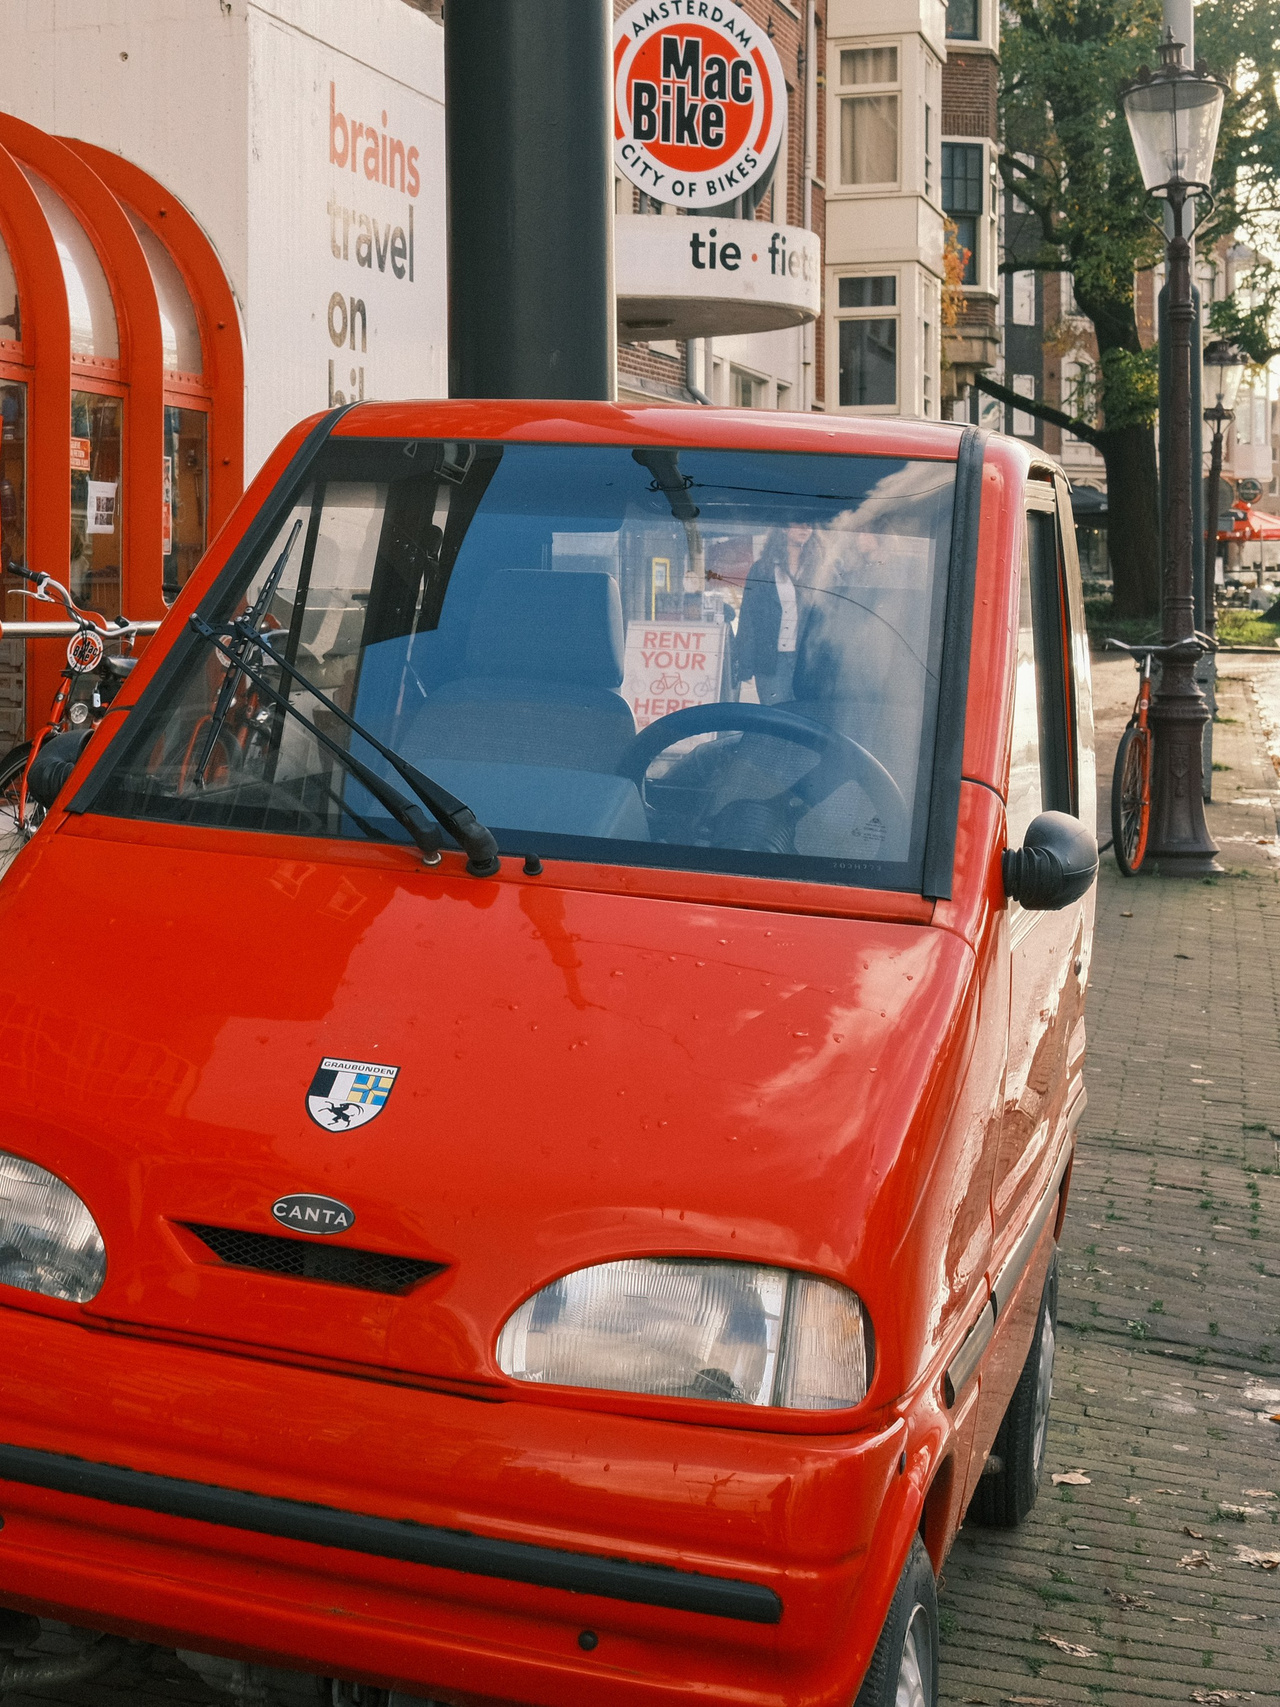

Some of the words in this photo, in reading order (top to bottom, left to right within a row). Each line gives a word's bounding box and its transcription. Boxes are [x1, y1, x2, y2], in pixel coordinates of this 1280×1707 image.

[632, 0, 752, 48] AMSTERDAM
[661, 36, 753, 104] Mac
[328, 80, 420, 198] brains
[632, 81, 725, 149] Bike
[621, 144, 665, 187] CITY
[672, 180, 697, 198] OF
[706, 153, 757, 196] BIKES
[327, 196, 414, 283] travel
[689, 228, 742, 272] tie
[327, 291, 367, 354] on
[640, 651, 707, 671] YOUR
[643, 631, 707, 650] RENT
[272, 1202, 349, 1227] CANTA
